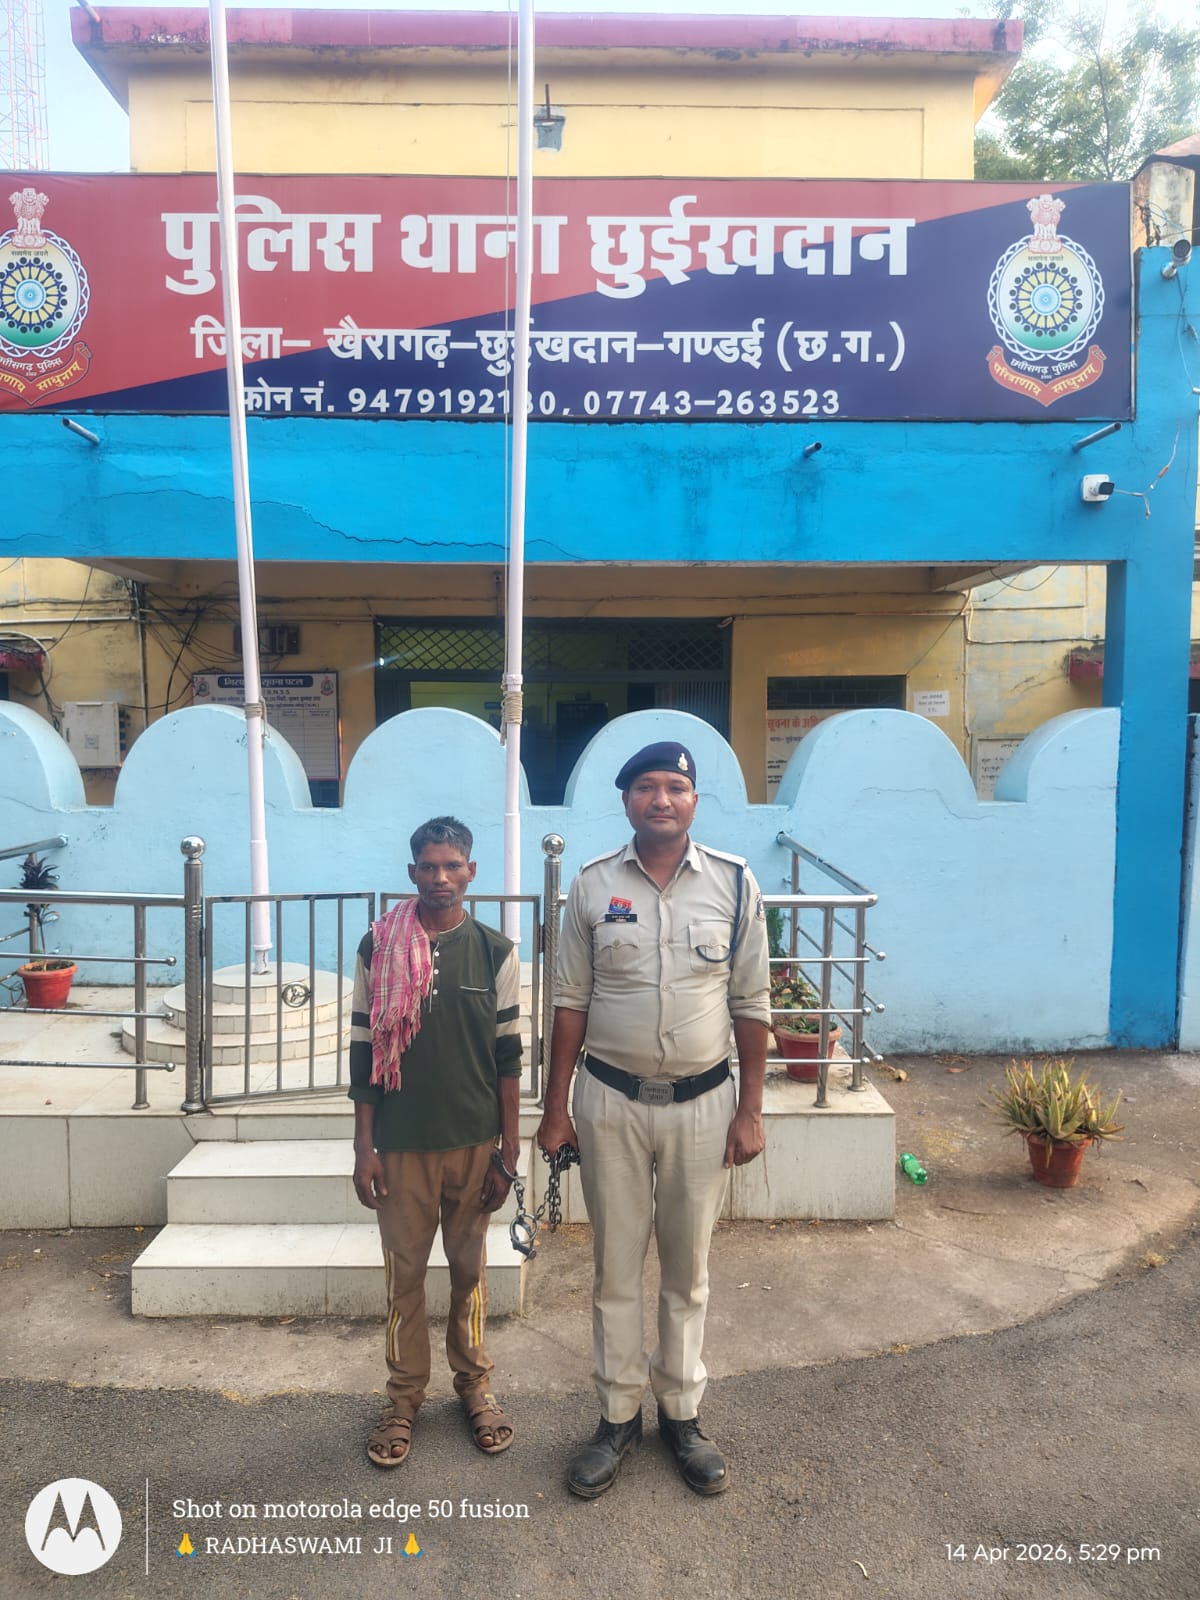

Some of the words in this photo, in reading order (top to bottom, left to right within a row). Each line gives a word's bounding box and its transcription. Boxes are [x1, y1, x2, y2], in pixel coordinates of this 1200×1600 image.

[400, 214, 568, 275] थाना
[586, 195, 916, 299] छुईखदान
[1051, 359, 1079, 376] पुलिस
